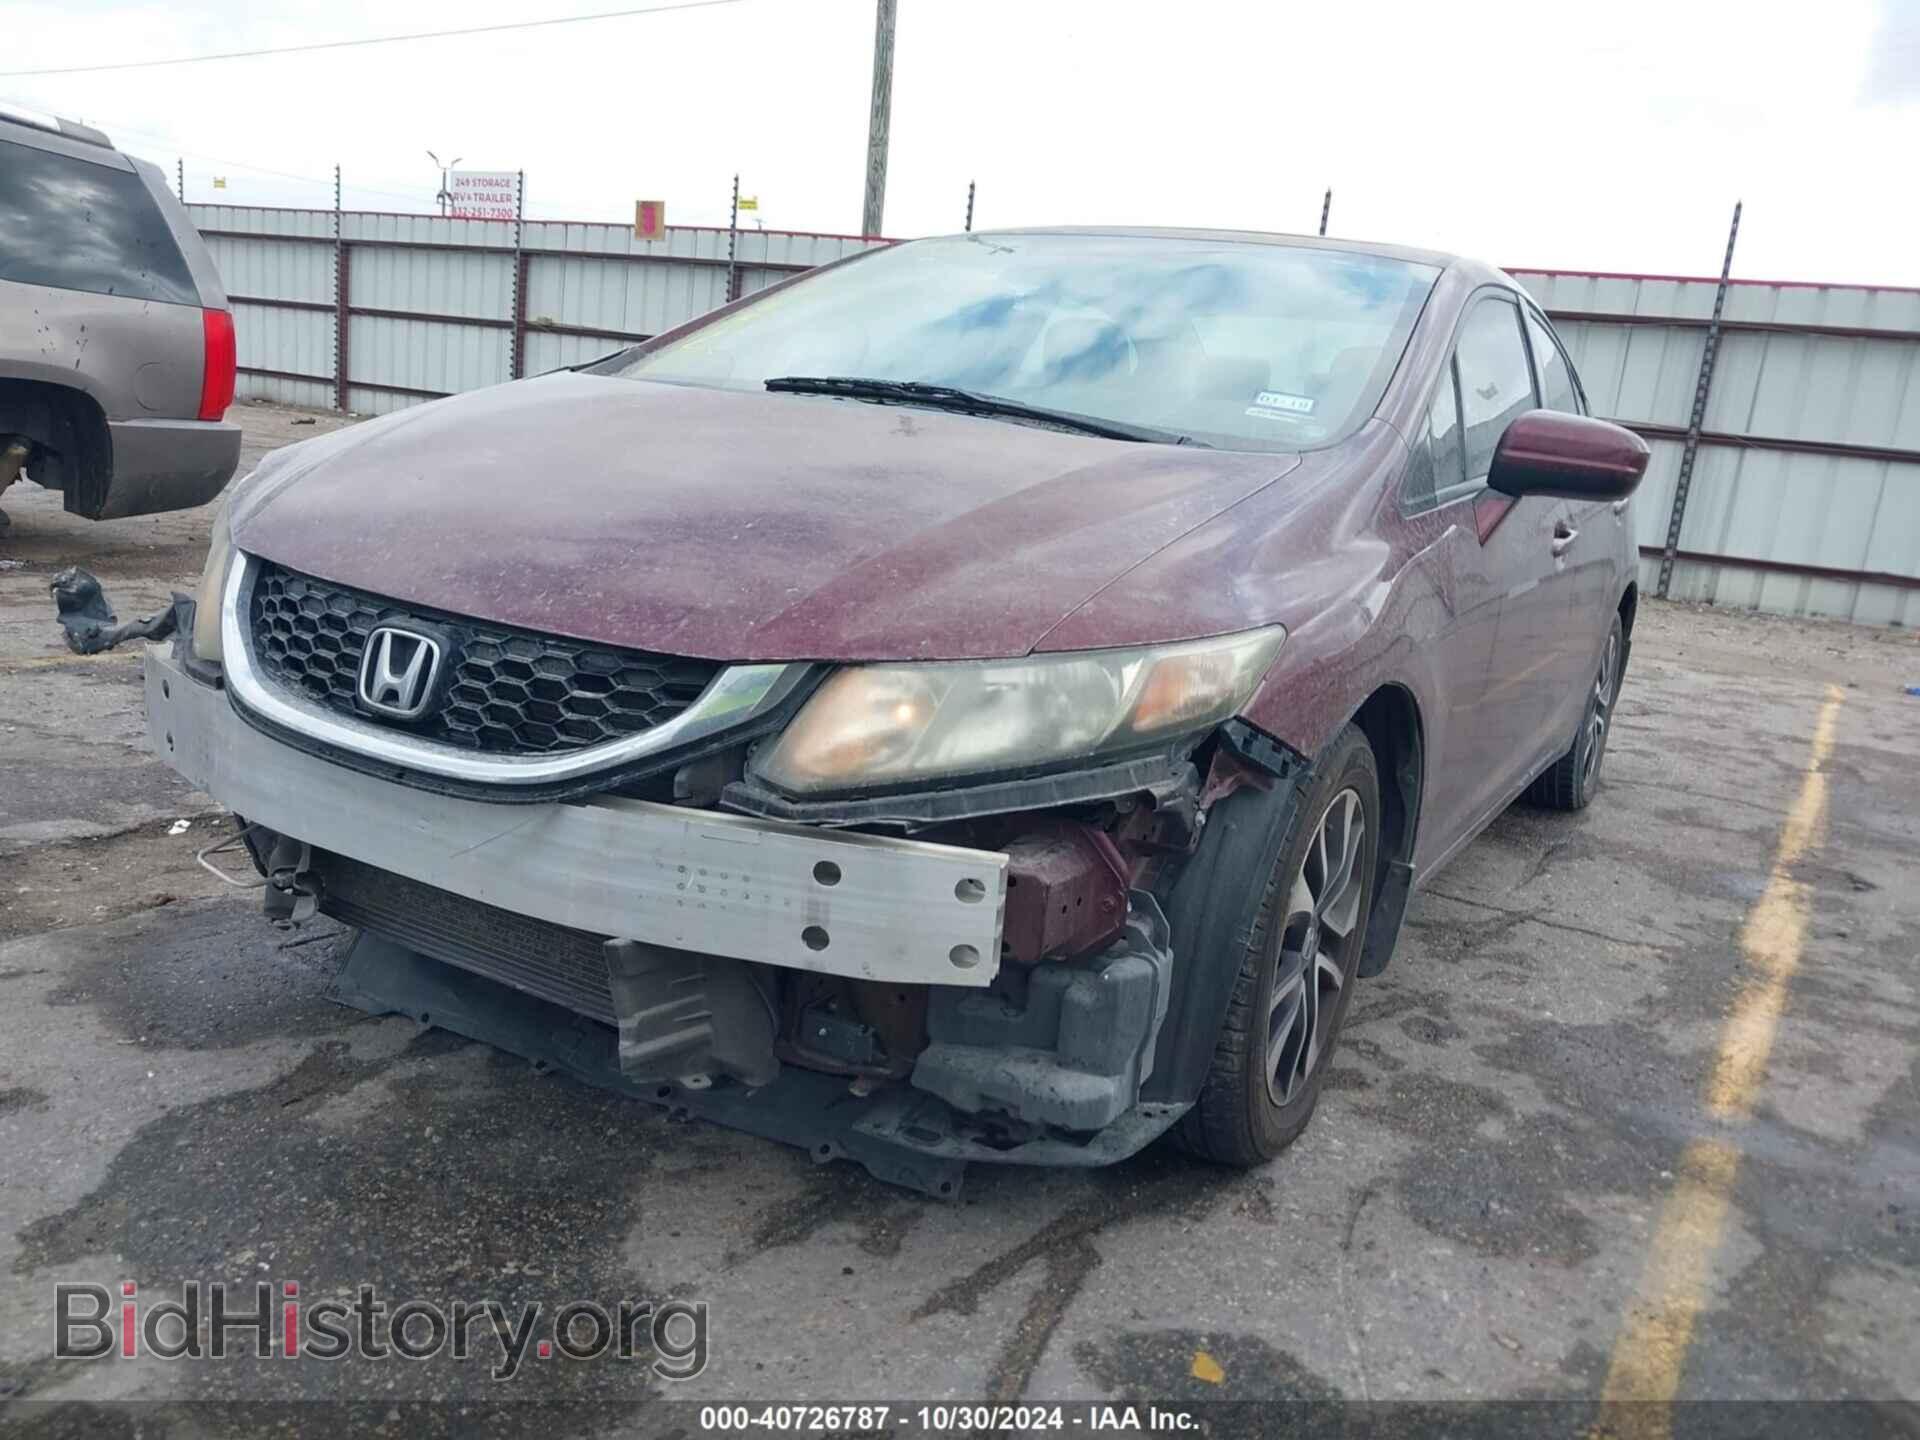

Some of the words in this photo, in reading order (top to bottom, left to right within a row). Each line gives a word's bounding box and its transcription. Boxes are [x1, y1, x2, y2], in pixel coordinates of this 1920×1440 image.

[455, 178, 470, 186] 249
[472, 178, 511, 188] STORAGE
[474, 193, 512, 203] TRAILER
